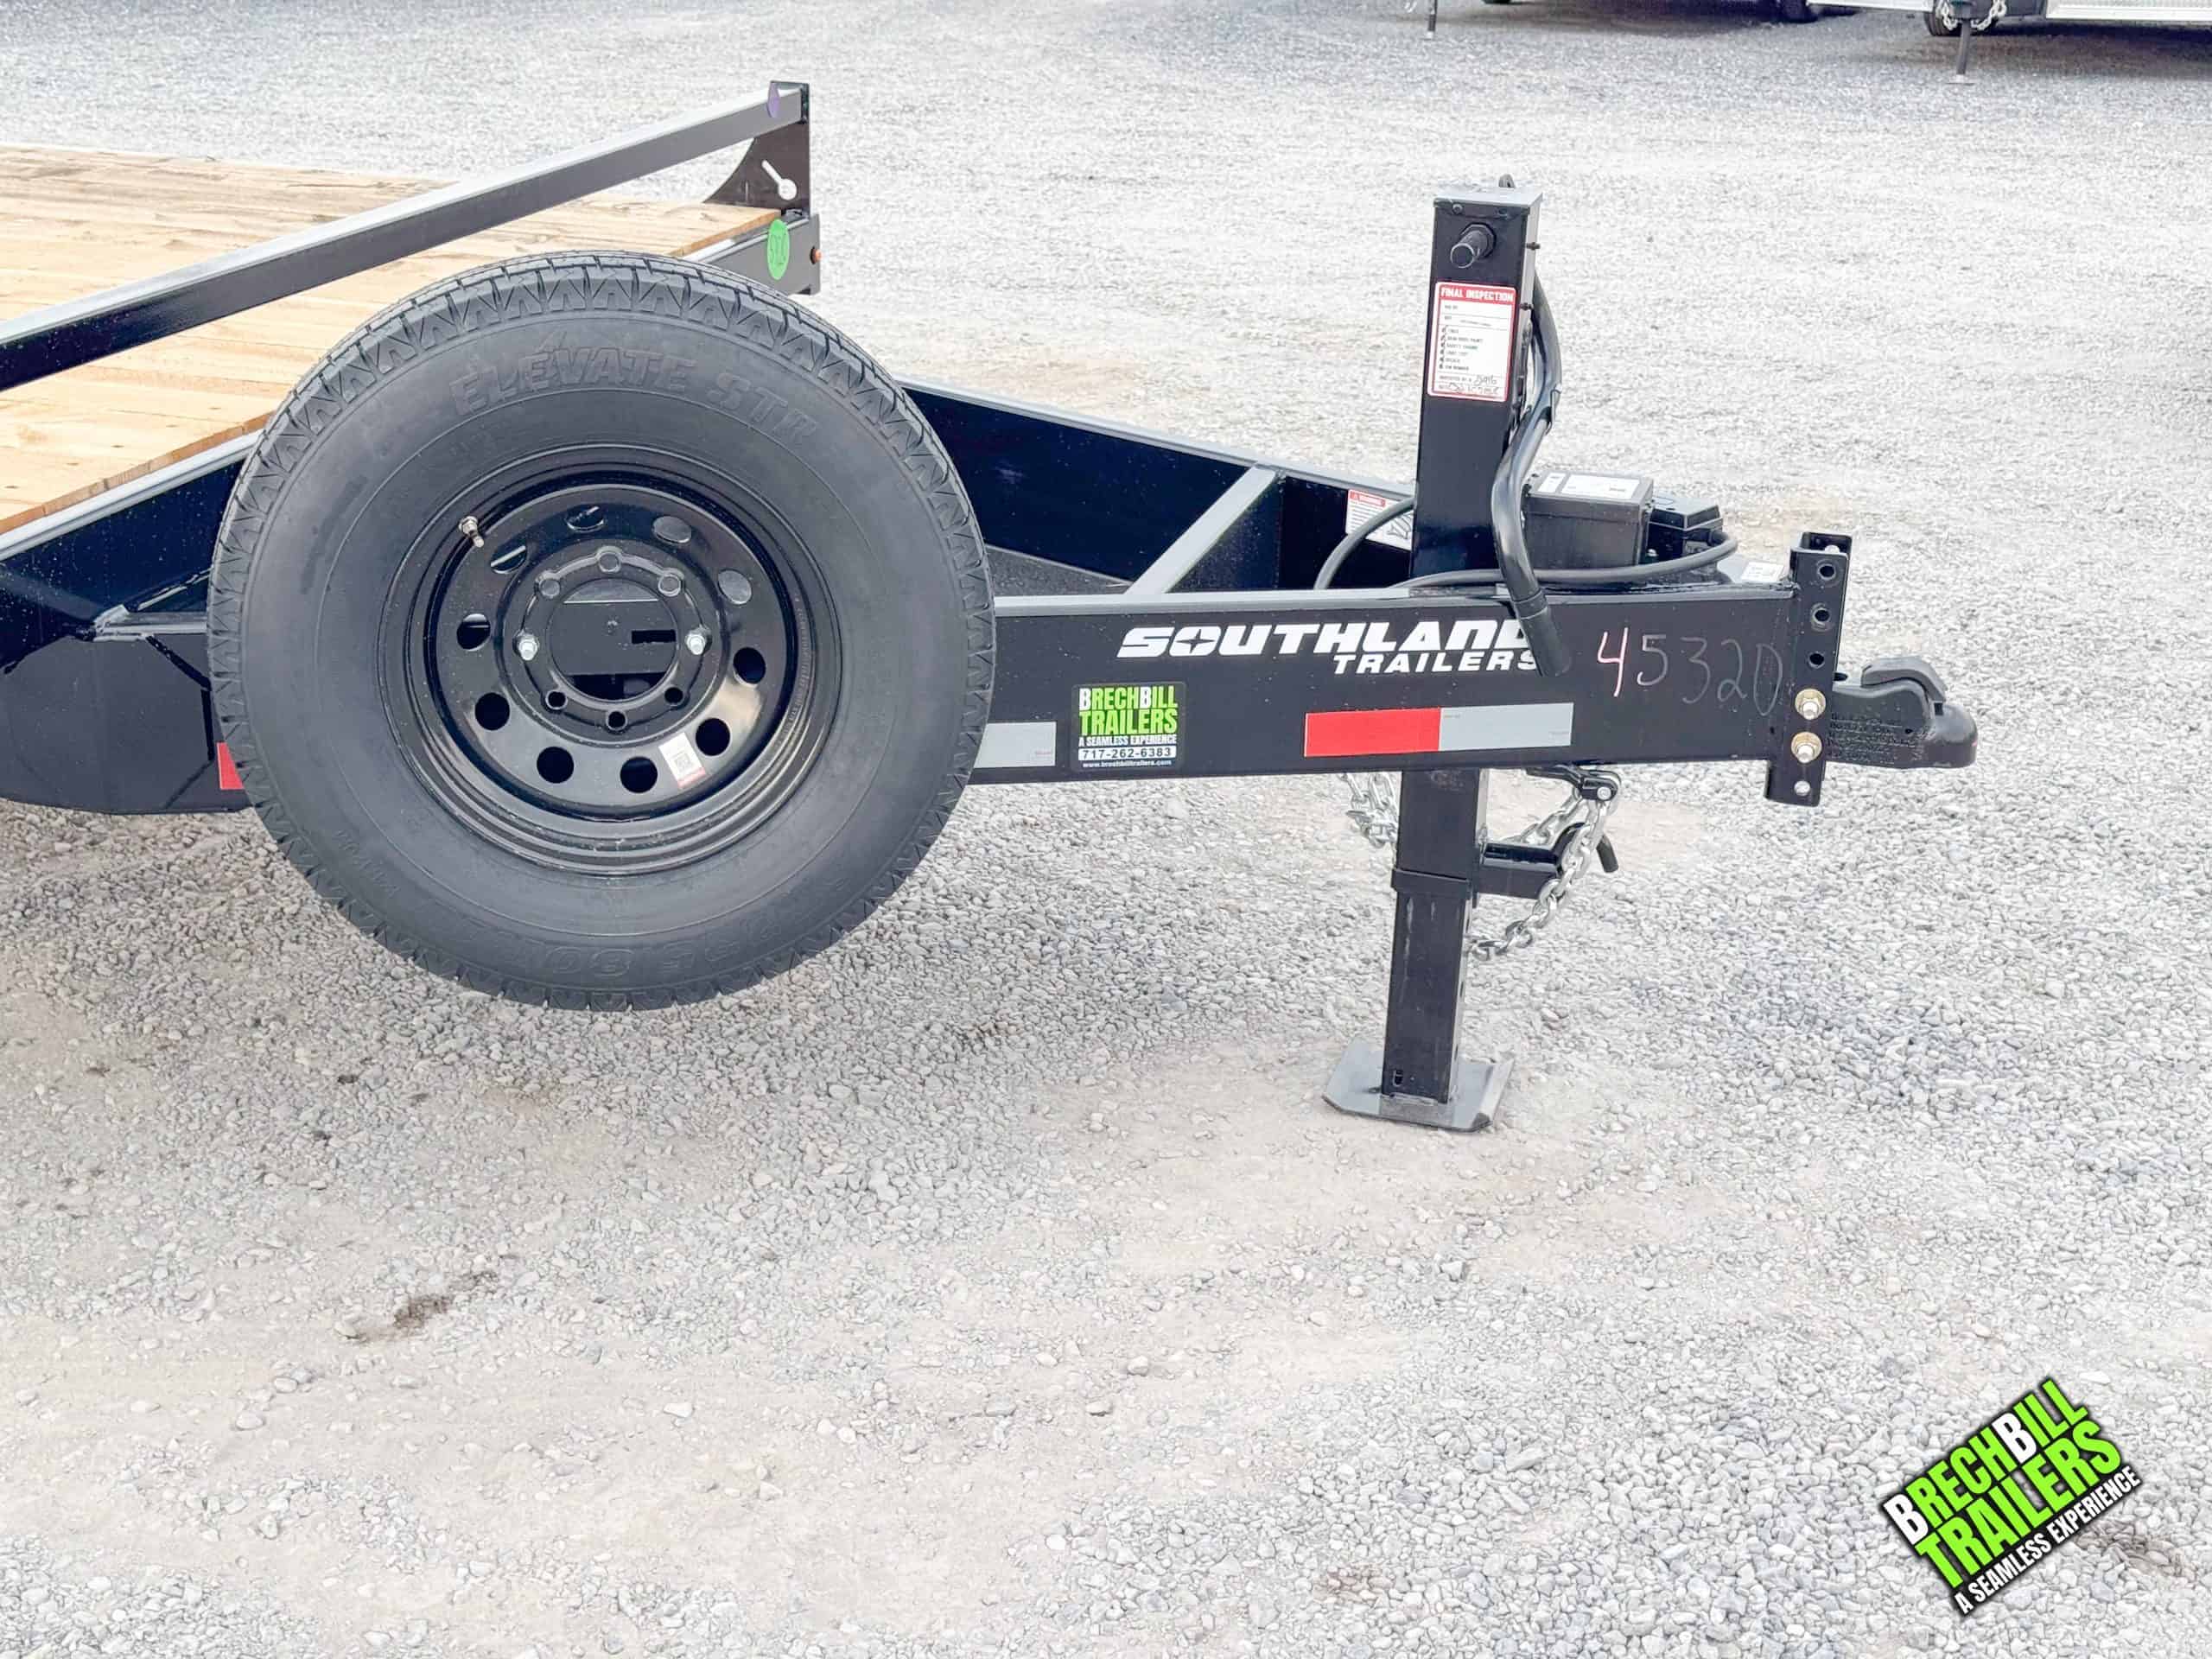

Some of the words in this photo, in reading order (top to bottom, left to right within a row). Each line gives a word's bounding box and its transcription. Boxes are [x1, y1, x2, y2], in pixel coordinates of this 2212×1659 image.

[1440, 288, 1464, 298] FINAL
[1465, 289, 1514, 302] INSPECTION
[1332, 649, 1536, 676] TRAILERS
[1596, 627, 1783, 717] 45320
[1079, 685, 1178, 710] BRECHBILL
[1079, 709, 1178, 736] TRAILERS
[1078, 736, 1085, 747] A
[1086, 735, 1128, 747] SEAMLESS
[1130, 734, 1177, 746] EXPERIENCE
[1083, 747, 1172, 759] 717-262-6383
